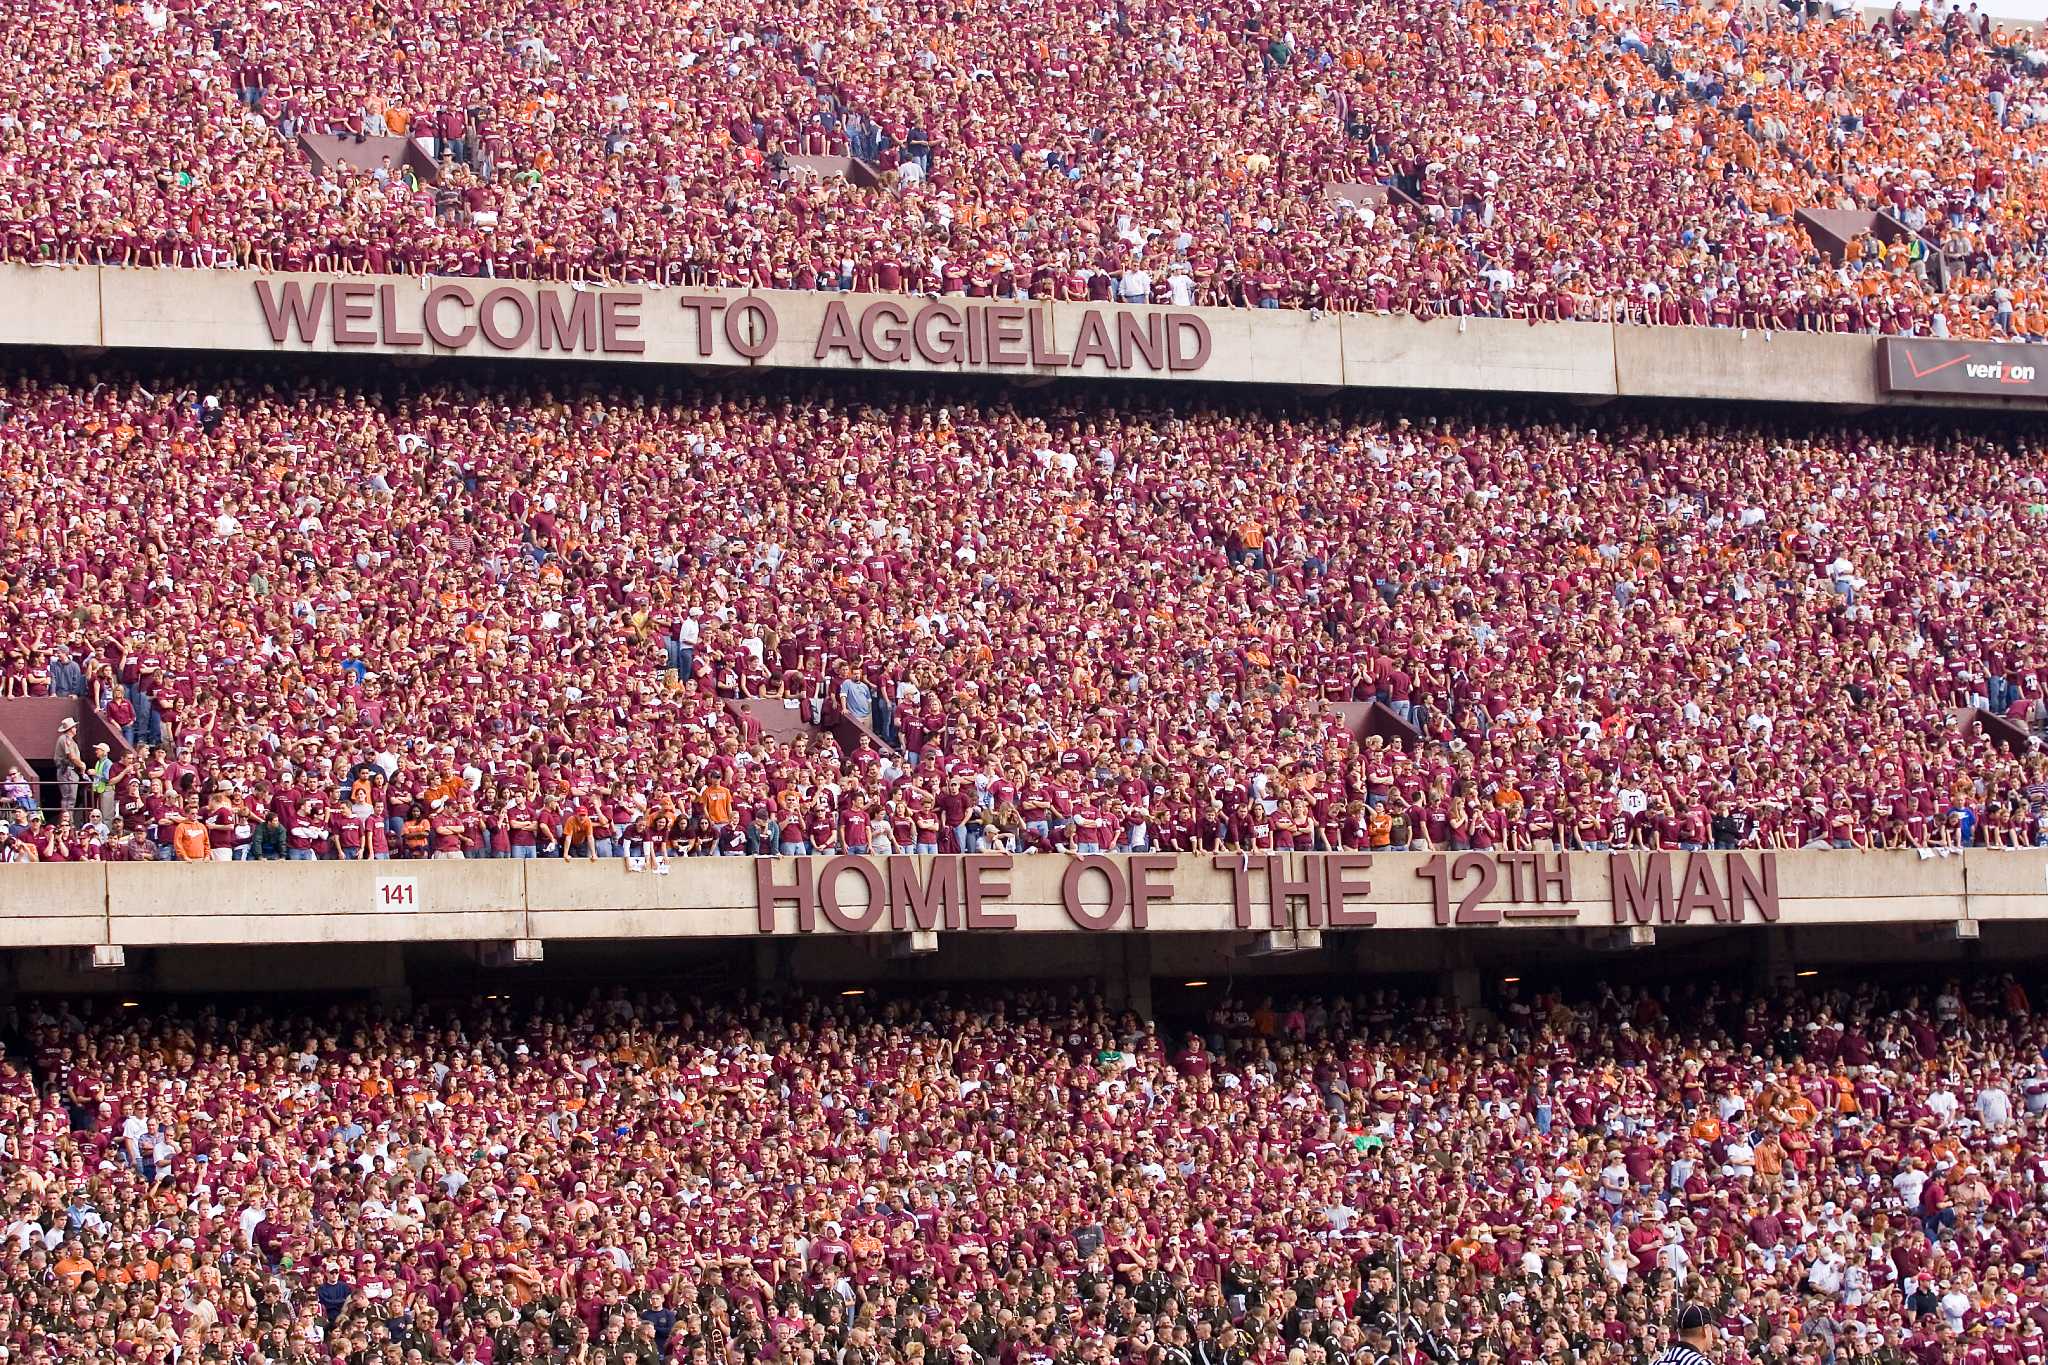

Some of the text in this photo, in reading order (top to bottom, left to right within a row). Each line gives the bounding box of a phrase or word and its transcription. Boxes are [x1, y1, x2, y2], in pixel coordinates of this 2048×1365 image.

[253, 280, 1212, 371] WELCOME TO AGGIELAND
[1966, 361, 2036, 384] verizon
[381, 884, 413, 904] 141
[755, 854, 1018, 932] HOME
[1061, 853, 1178, 930] OF
[1213, 854, 1377, 928] THE
[1609, 852, 1780, 923] MAN
